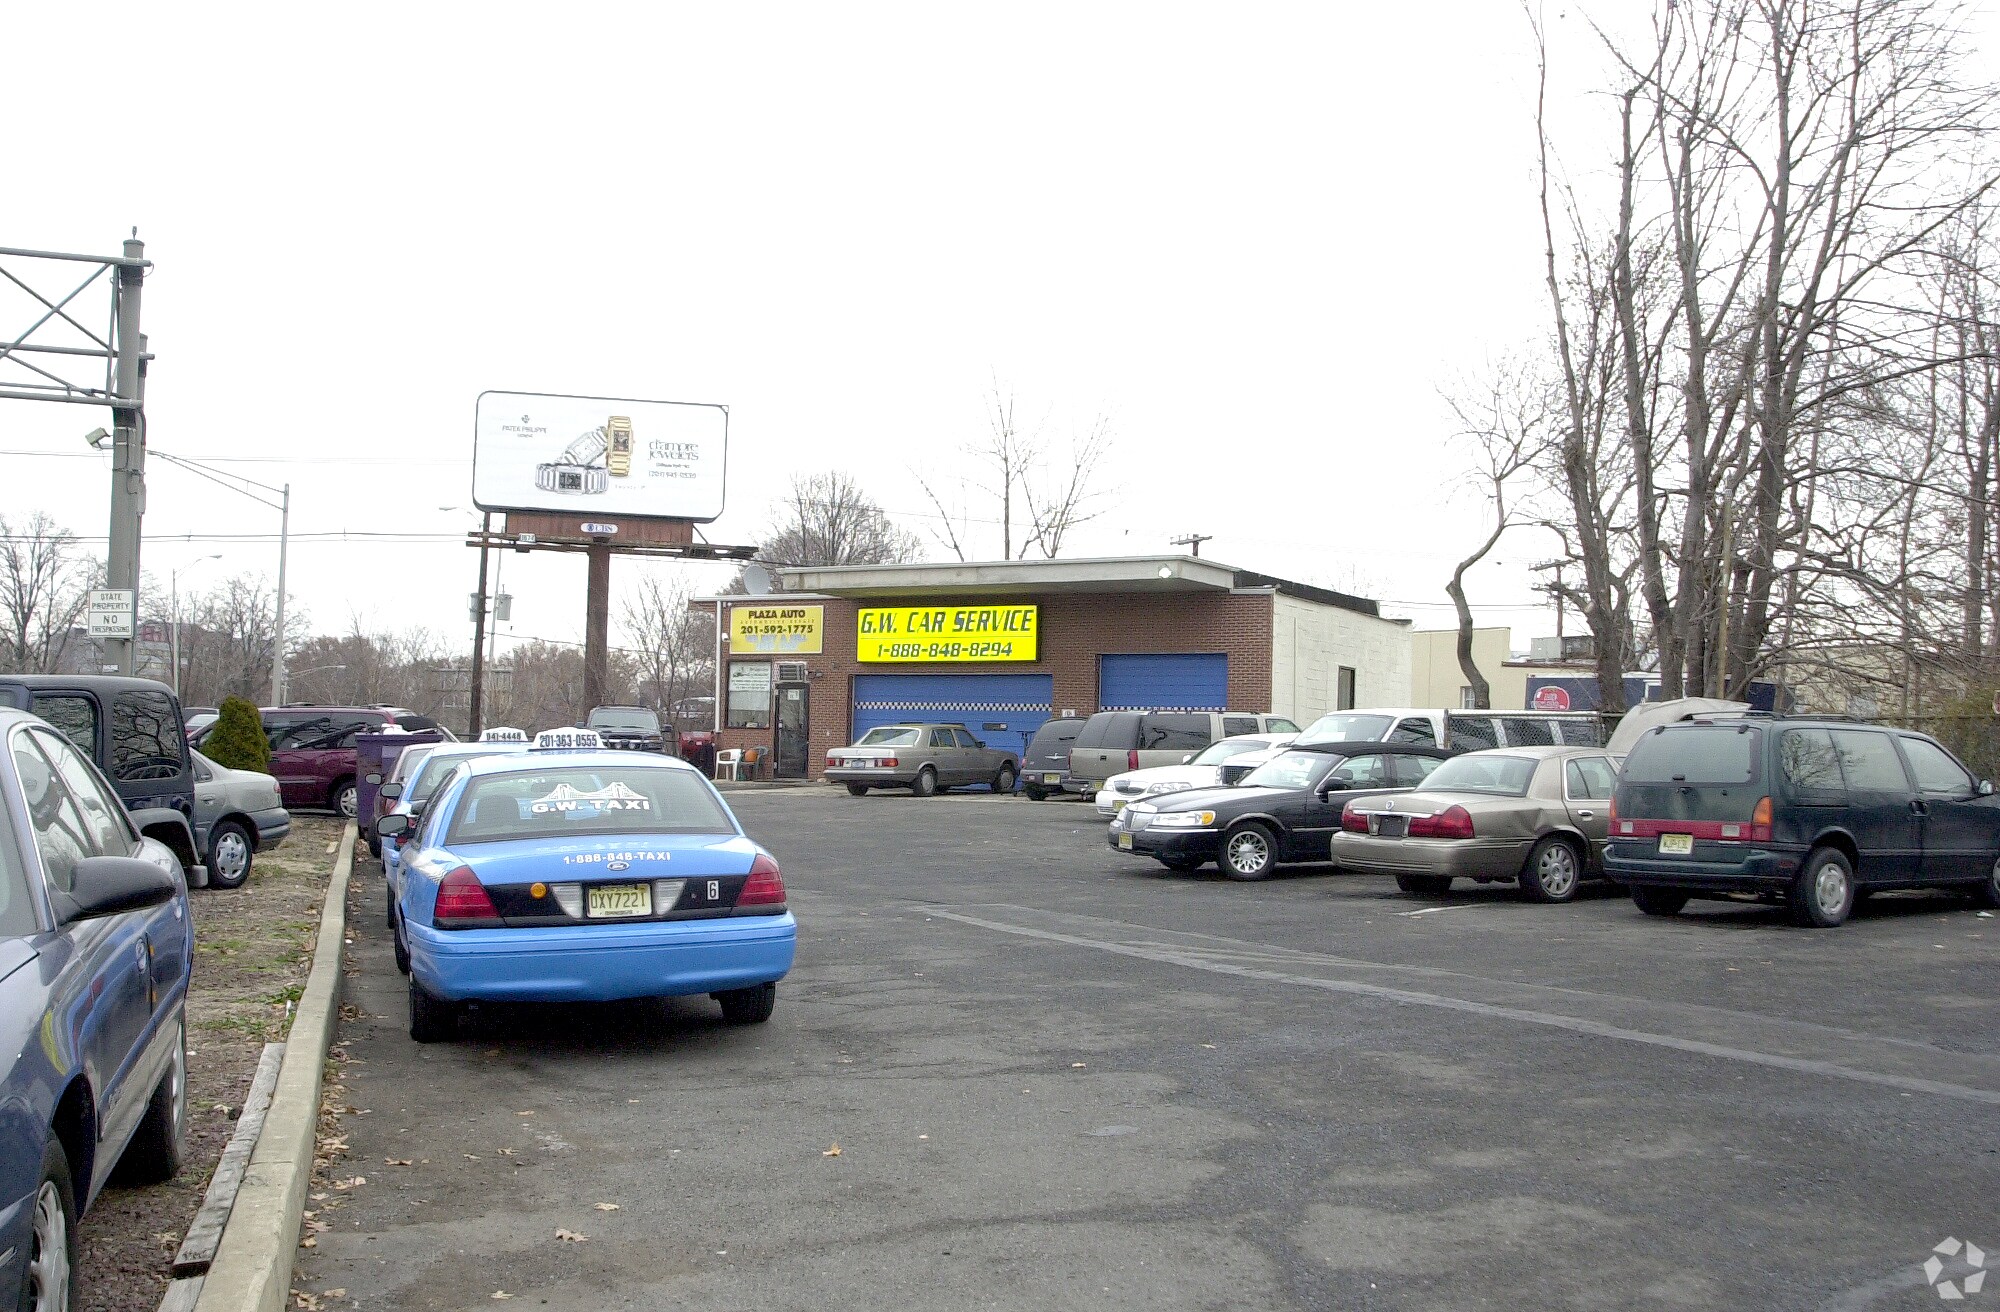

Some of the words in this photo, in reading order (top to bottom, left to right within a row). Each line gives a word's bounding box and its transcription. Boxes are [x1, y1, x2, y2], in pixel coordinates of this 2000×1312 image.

[100, 593, 122, 601] STATE
[92, 602, 130, 610] PROPERTY
[103, 614, 118, 624] NO
[748, 609, 778, 619] PLAZA
[780, 609, 806, 618] AUTO
[861, 612, 897, 634] G.W.
[906, 611, 946, 633] CAR
[952, 609, 1035, 633] SERVICE
[92, 625, 130, 633] TRESPASSING
[740, 624, 814, 634] 201-592-1775
[877, 641, 1013, 658] 1-888-848-8294
[539, 734, 598, 748] 201-363-0555
[531, 801, 584, 814] G.W.
[590, 800, 651, 811] TAXI
[563, 851, 671, 865] 1-888-848-TAXI
[709, 882, 717, 899] 6
